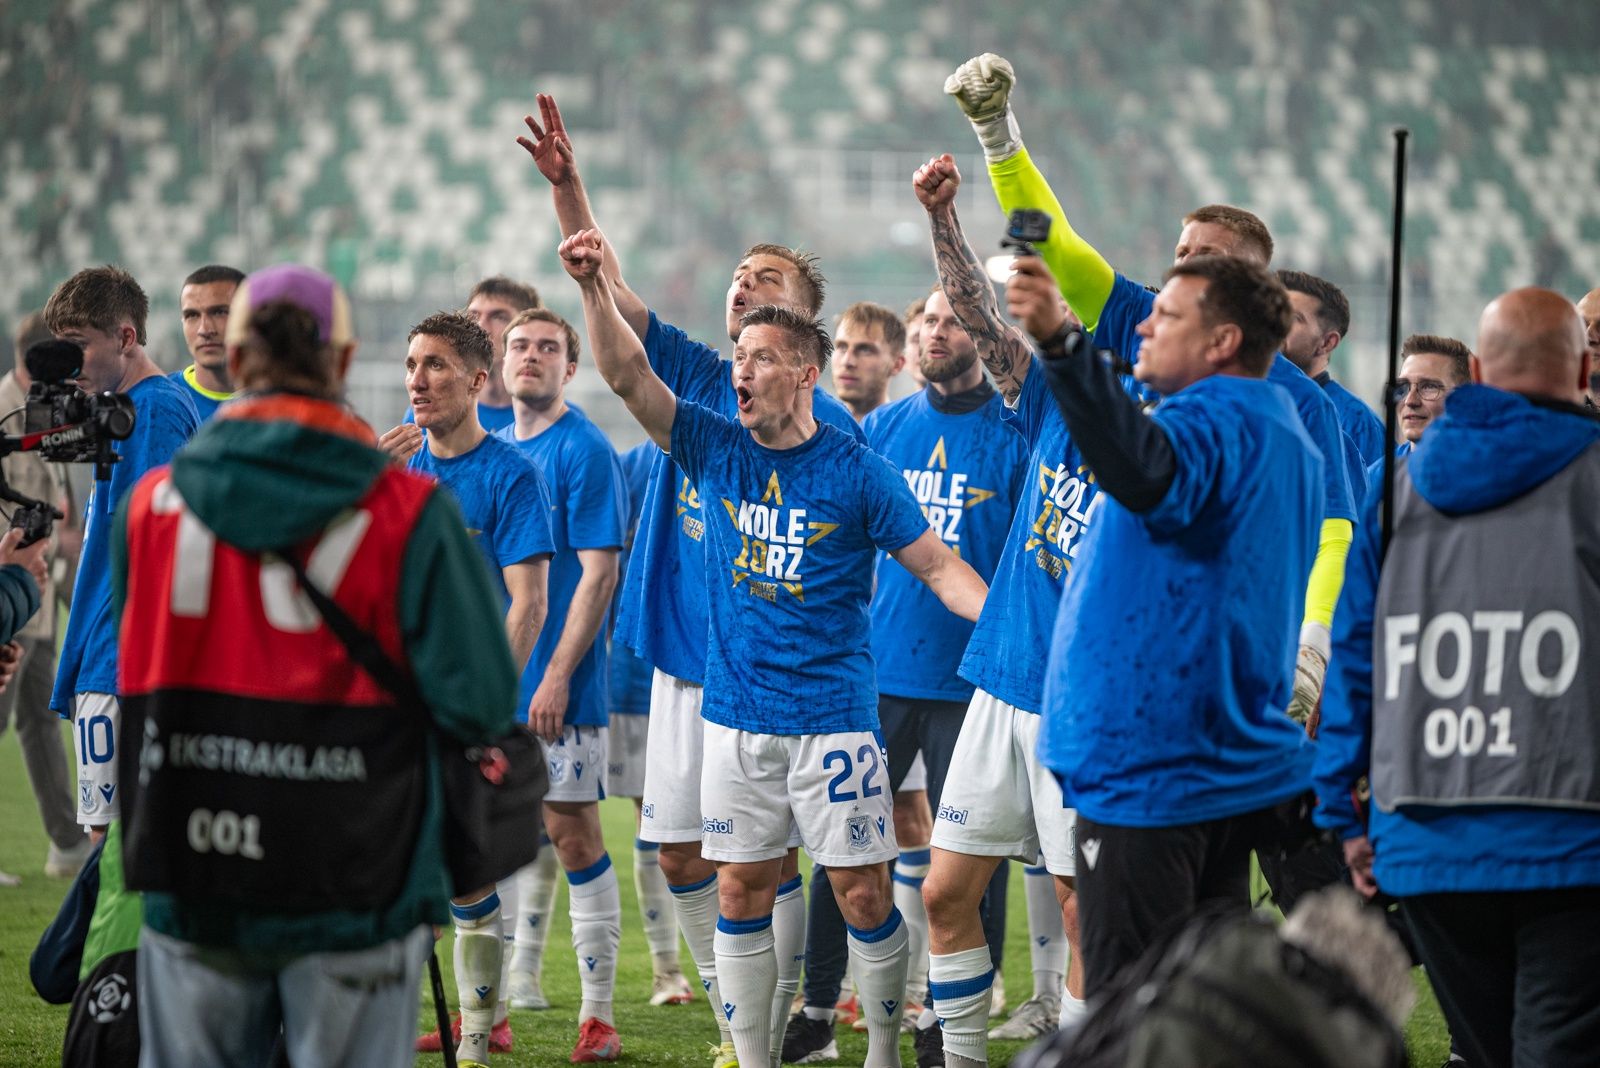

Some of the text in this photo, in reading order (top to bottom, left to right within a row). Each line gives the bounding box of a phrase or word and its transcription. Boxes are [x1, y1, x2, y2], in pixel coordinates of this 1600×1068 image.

[41, 426, 84, 447] RONIN
[738, 499, 807, 545] KOLE
[1384, 610, 1581, 700] FOTO
[78, 715, 115, 766] 10
[169, 732, 368, 782] EKSTRAKLASA
[1424, 706, 1518, 758] 001
[823, 744, 882, 803] 22
[187, 808, 265, 860] 001
